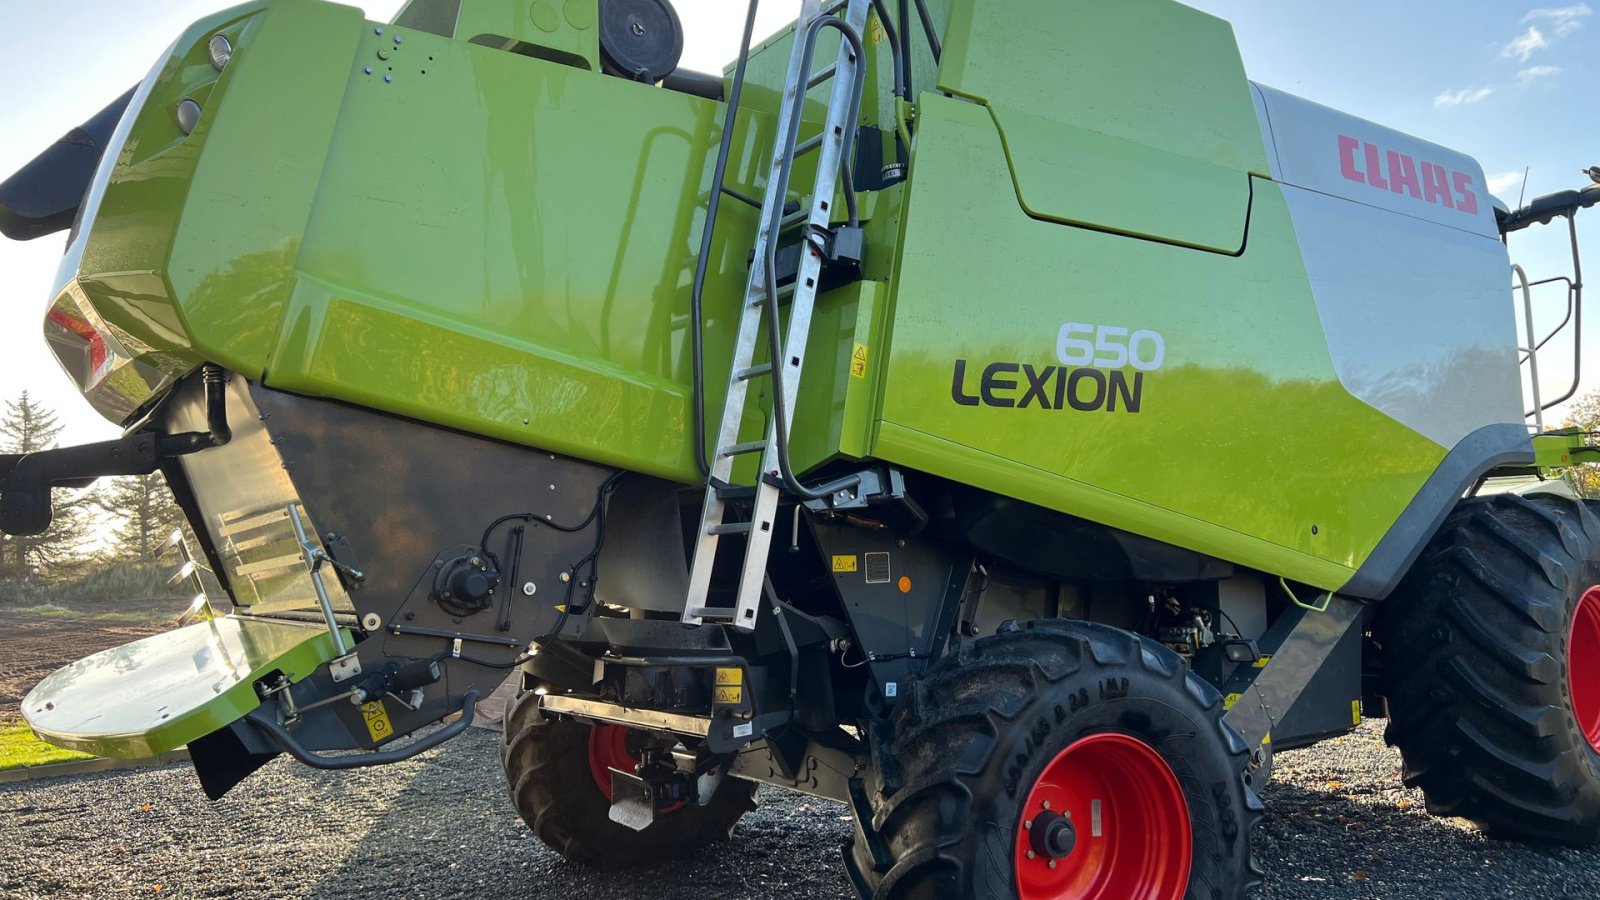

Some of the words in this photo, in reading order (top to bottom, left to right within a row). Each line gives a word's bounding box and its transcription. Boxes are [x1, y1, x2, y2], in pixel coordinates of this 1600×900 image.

[1338, 134, 1478, 215] CLAAS
[1056, 322, 1165, 371] 650
[951, 359, 1144, 413] LEXION
